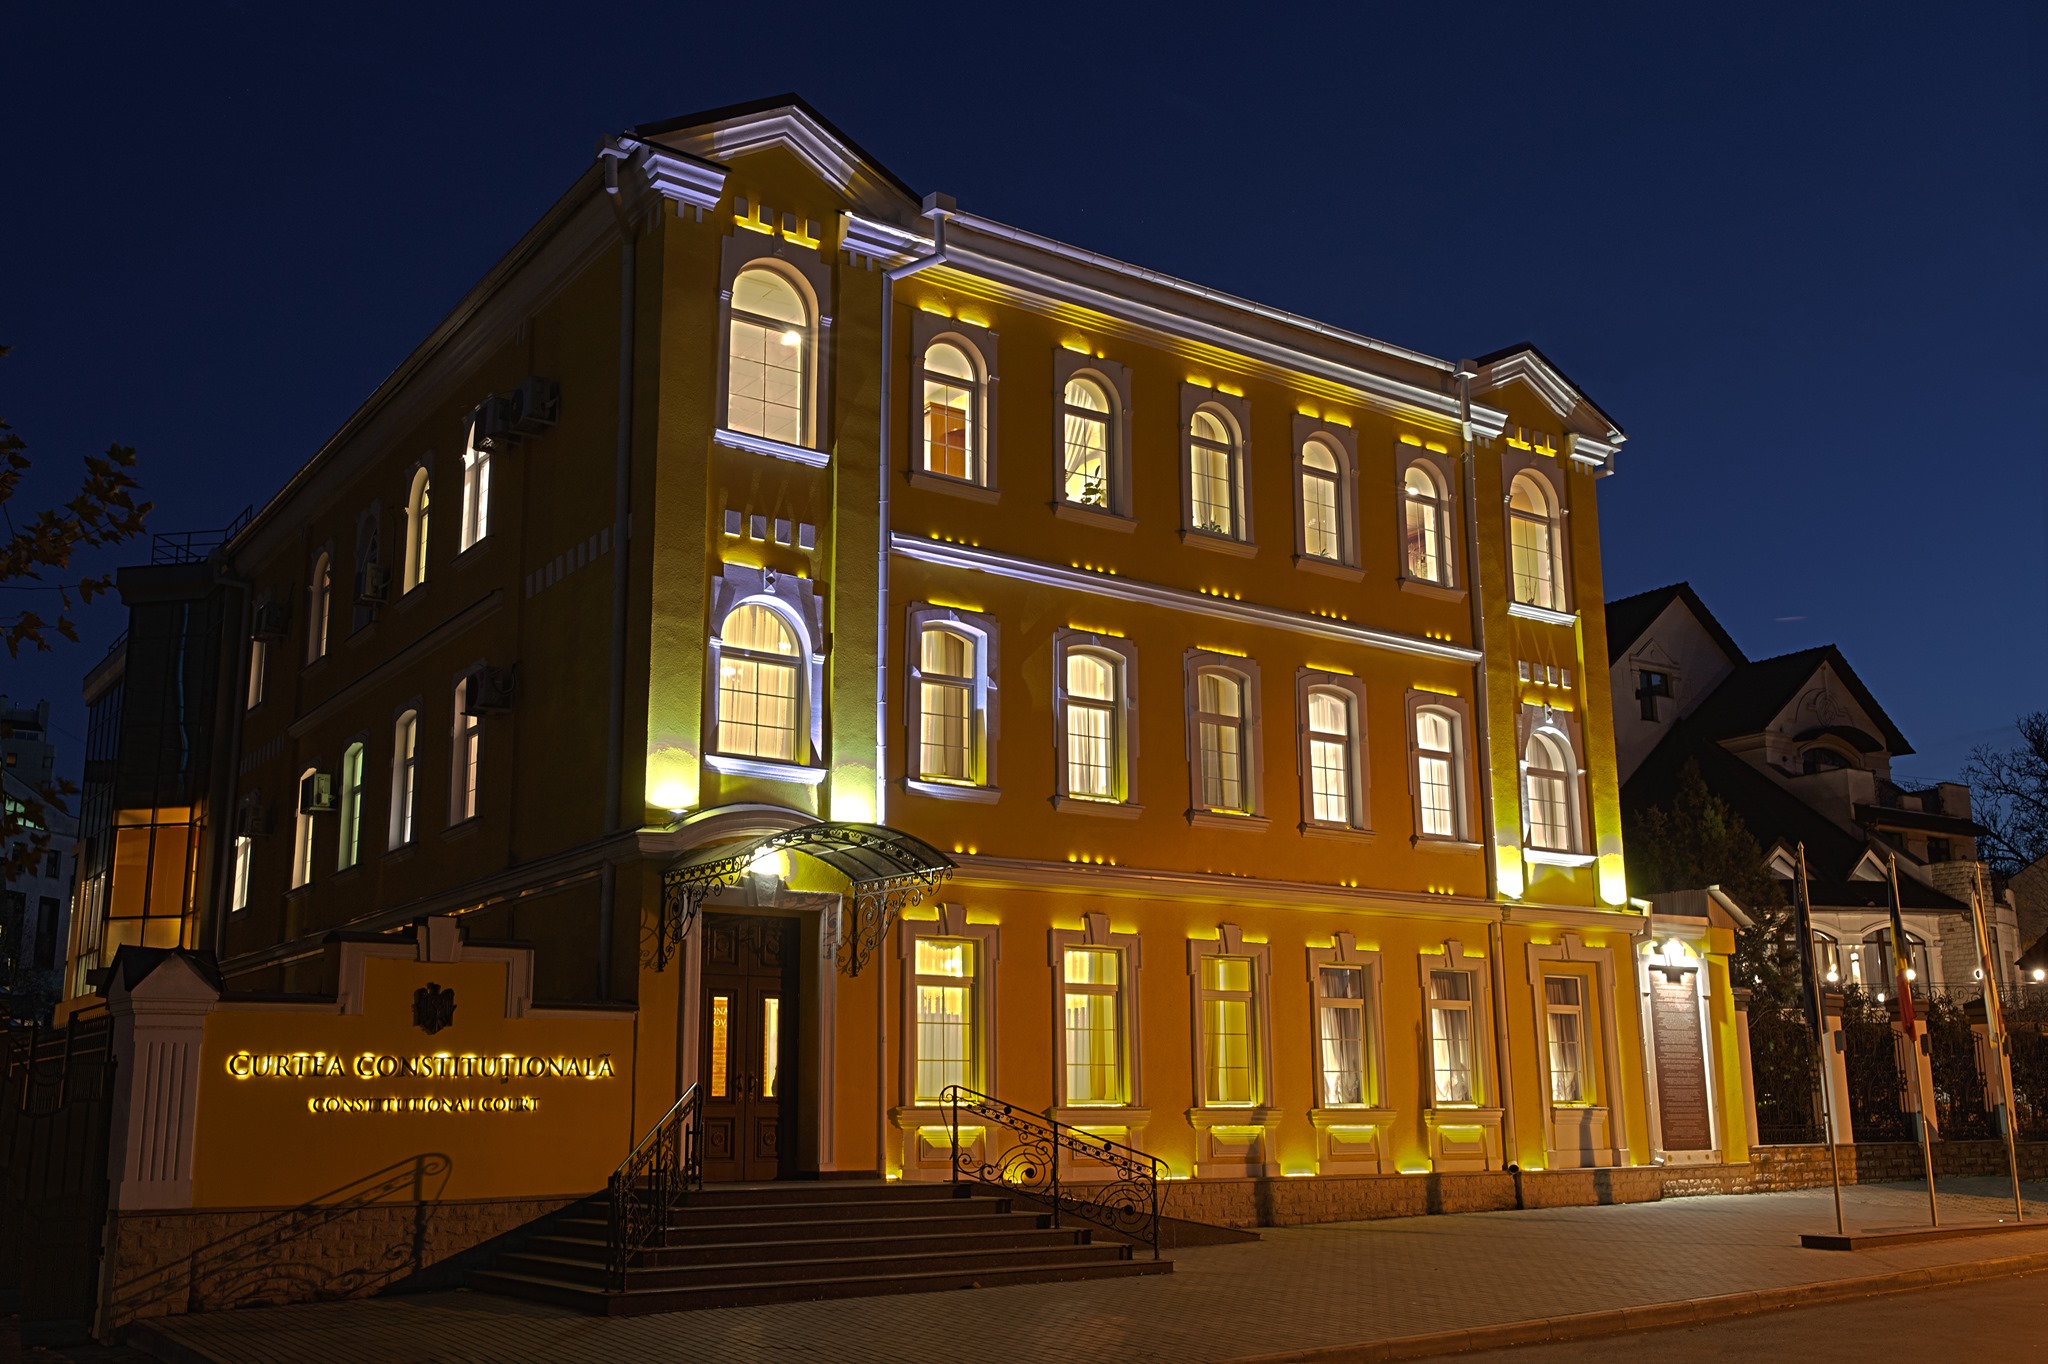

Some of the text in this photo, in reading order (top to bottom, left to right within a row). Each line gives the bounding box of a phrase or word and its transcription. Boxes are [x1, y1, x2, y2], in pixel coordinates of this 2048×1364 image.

[228, 1052, 346, 1077] CURTEA
[311, 1096, 540, 1113] CONSTITUTIONAL COURT
